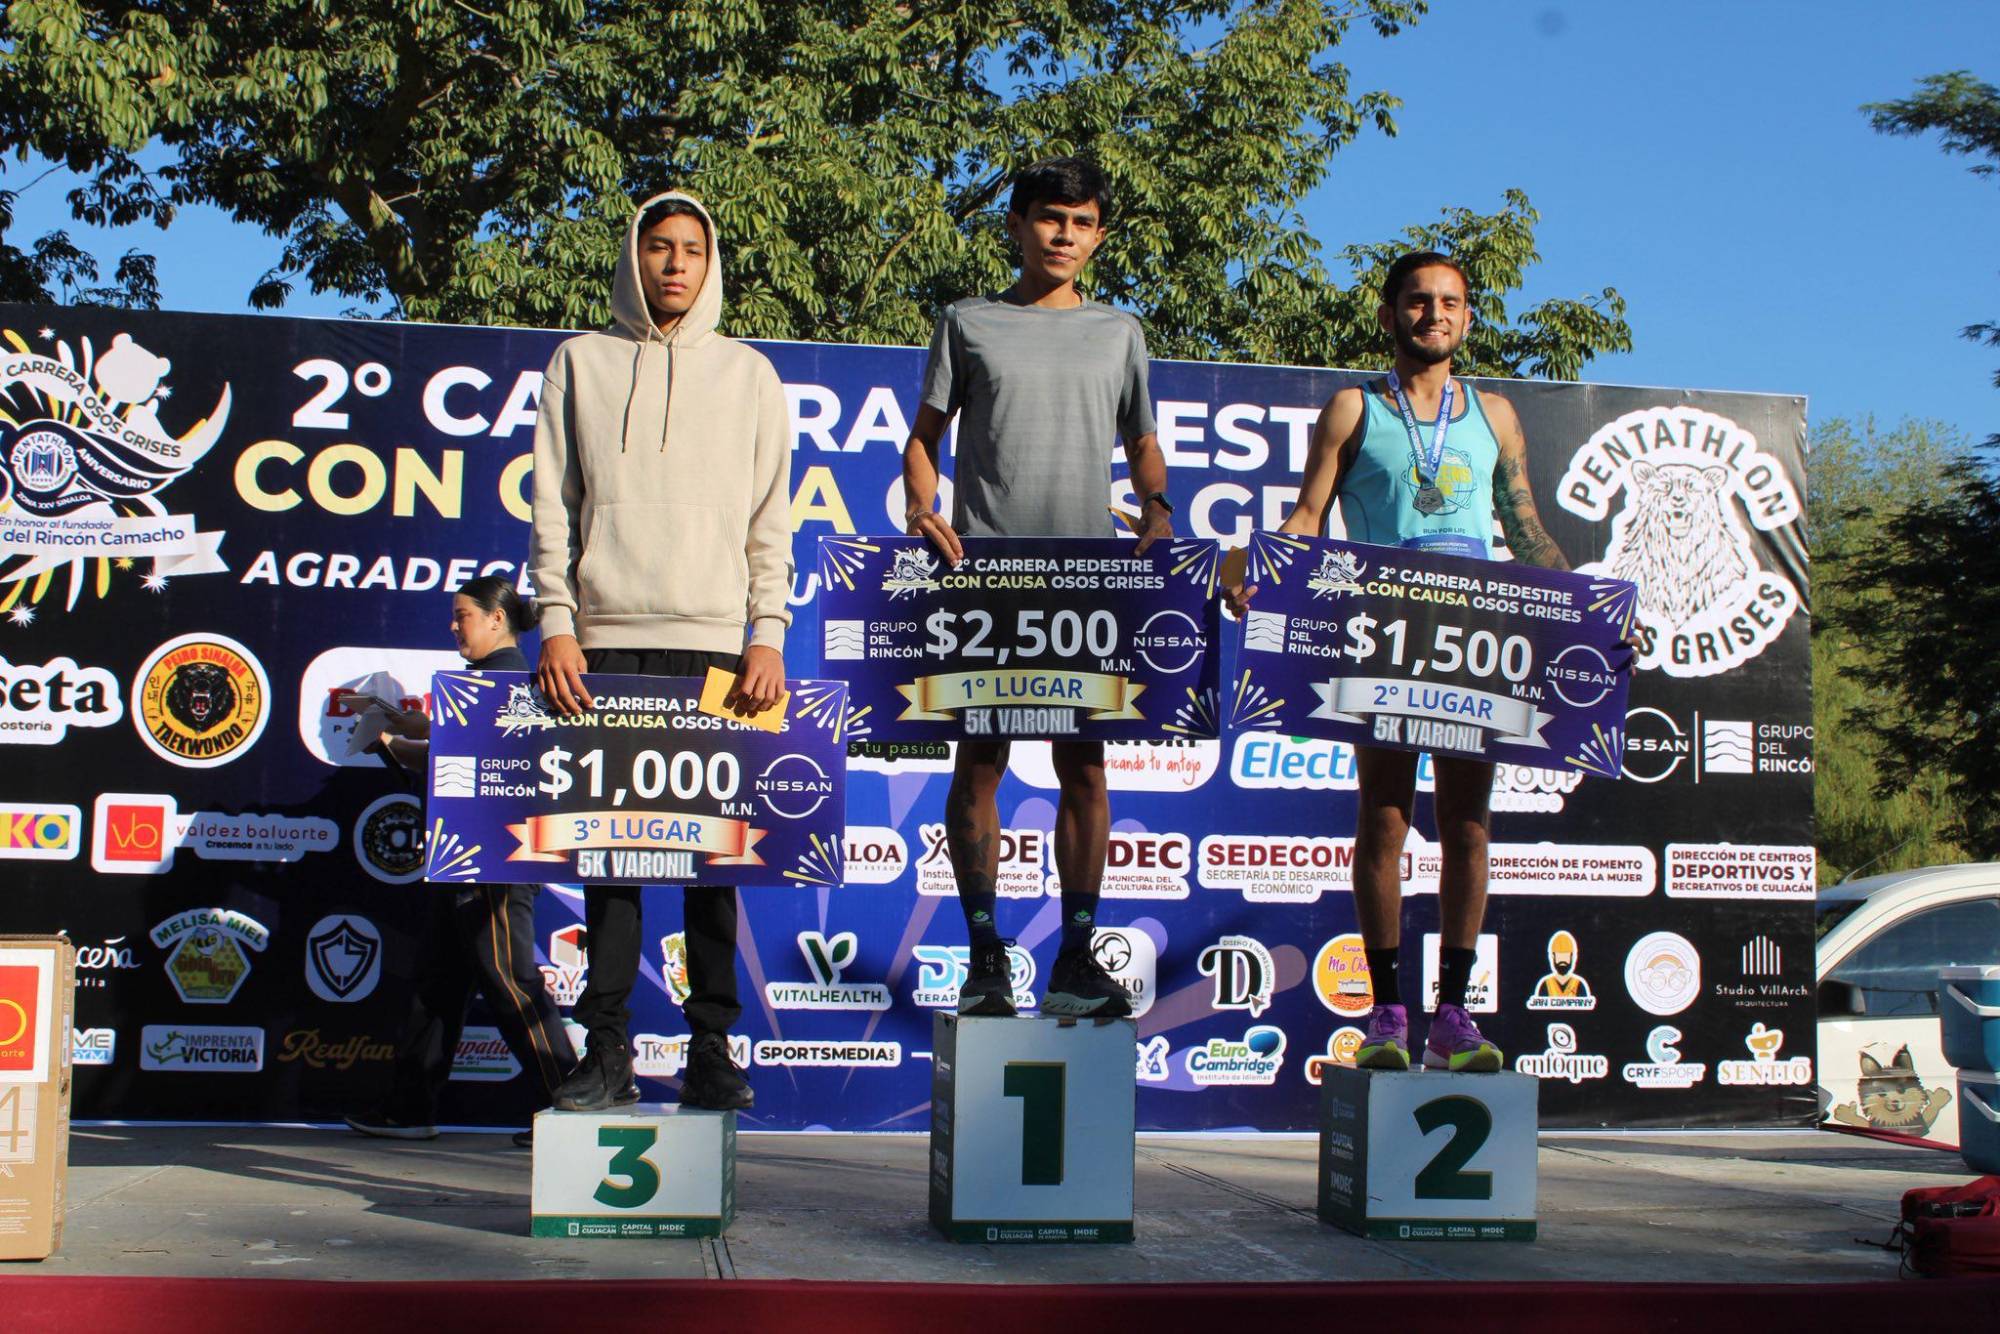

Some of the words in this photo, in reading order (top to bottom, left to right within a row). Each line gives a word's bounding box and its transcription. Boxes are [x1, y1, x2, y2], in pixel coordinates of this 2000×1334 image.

[7, 361, 86, 396] CARRERA
[84, 396, 122, 434] OSOS
[122, 430, 182, 458] GRISES
[77, 448, 152, 490] ANIVERSARIO
[1569, 418, 1787, 517] PENTATHLON
[234, 440, 464, 520] CON
[13, 518, 48, 530] honor
[61, 521, 114, 531] fundador
[3, 529, 31, 544] del
[35, 530, 97, 547] Rincón
[101, 528, 186, 546] Camacho
[974, 558, 1061, 573] CARRERA
[1064, 558, 1154, 574] PEDESTRE
[942, 575, 985, 590] CON
[987, 575, 1047, 590] CAUSA
[1052, 576, 1098, 590] OSOS
[1104, 576, 1166, 590] GRISES
[1399, 568, 1482, 593] CARRERA
[1486, 581, 1574, 606] PEDESTRE
[1366, 581, 1408, 599] CON
[1408, 586, 1469, 608] CAUSA
[1472, 595, 1521, 615] OSOS
[1523, 603, 1583, 625] GRISES
[870, 622, 918, 633] GRUPO
[1291, 617, 1338, 634] GRUPO
[1672, 582, 1785, 664] GRISES
[870, 634, 893, 645] DEL
[925, 607, 1118, 665] $2,500
[1101, 659, 1135, 672] M.N.
[1133, 636, 1207, 648] NISSAN
[1289, 630, 1313, 643] DEL
[870, 645, 923, 658] RINCÓN
[1288, 643, 1341, 659] RINCÓN
[1343, 612, 1533, 682] $1,500
[1511, 682, 1546, 701] M.N.
[200, 647, 247, 678] SINALOA
[1546, 665, 1617, 687] NISSAN
[995, 676, 1084, 700] LUGAR
[592, 696, 681, 712] CARRERA
[1407, 686, 1493, 720] LUGAR
[603, 714, 668, 729] CAUSA
[671, 717, 723, 731] OSOS
[964, 708, 991, 736] 5K
[997, 707, 1080, 735] VARONIL
[154, 720, 244, 757] TAEKWONDO
[1373, 714, 1401, 743] 5K
[1406, 716, 1487, 755] VARONIL
[889, 743, 947, 757] pasión
[1759, 742, 1787, 755] DEL
[480, 760, 531, 771] GRUPO
[1166, 751, 1202, 786] antojo
[1759, 757, 1815, 773] RINCÓ
[480, 773, 505, 783] DEL
[537, 745, 741, 806] $1,000
[720, 802, 757, 816] M.N.
[480, 783, 536, 797] RINCÓN
[755, 780, 833, 793] NISSAN
[177, 822, 239, 838] valdez
[246, 822, 329, 841] baluarte
[609, 818, 702, 845] LUGAR
[1490, 855, 1560, 869] DIRECCIÓN
[1562, 858, 1579, 869] DE
[1582, 860, 1643, 870] FOMENTO
[1672, 849, 1737, 861] DIRECCIÓN
[1739, 852, 1755, 861] DE
[1758, 852, 1812, 863] CENTROS
[576, 850, 605, 878] 5K
[610, 850, 698, 879] VARONIL
[1672, 863, 1795, 880] DEPORTIVOS
[1799, 866, 1813, 881] Y
[1025, 871, 1039, 881] de
[1107, 875, 1153, 883] MUNICIPAL
[1155, 876, 1173, 884] DEL
[1206, 869, 1270, 881] SECRETARÍA
[1272, 870, 1286, 881] DE
[1490, 869, 1555, 881] ECONÓMICO
[1558, 872, 1588, 881] PARA
[1590, 872, 1604, 881] LA
[1609, 873, 1643, 882] MUJER
[922, 882, 954, 892] Cultura
[1003, 883, 1039, 894] Deporte
[1113, 883, 1153, 891] CULTURA
[1251, 883, 1314, 894] ECONÓMICO
[1671, 883, 1743, 892] RECREATIVOS
[1745, 883, 1760, 892] DE
[1761, 883, 1813, 893] CULIACÁN
[156, 913, 220, 943] MELISA
[227, 916, 263, 944] MIEL
[1716, 984, 1755, 996] Studio
[1760, 984, 1809, 996] VillArch
[1530, 999, 1548, 1007] JAN
[1550, 998, 1594, 1007] COMPANY
[184, 1035, 255, 1049] IMPRENTA
[180, 1047, 259, 1064] VICTORIA
[759, 1046, 887, 1061] SPORTSMEDIA
[1209, 1043, 1248, 1058] Euro
[1190, 1052, 1275, 1075] Cambridge
[1003, 1061, 1067, 1186] 1
[1412, 1094, 1493, 1201] 2
[592, 1125, 661, 1209] 3
[1481, 1226, 1505, 1234] IMDEC
